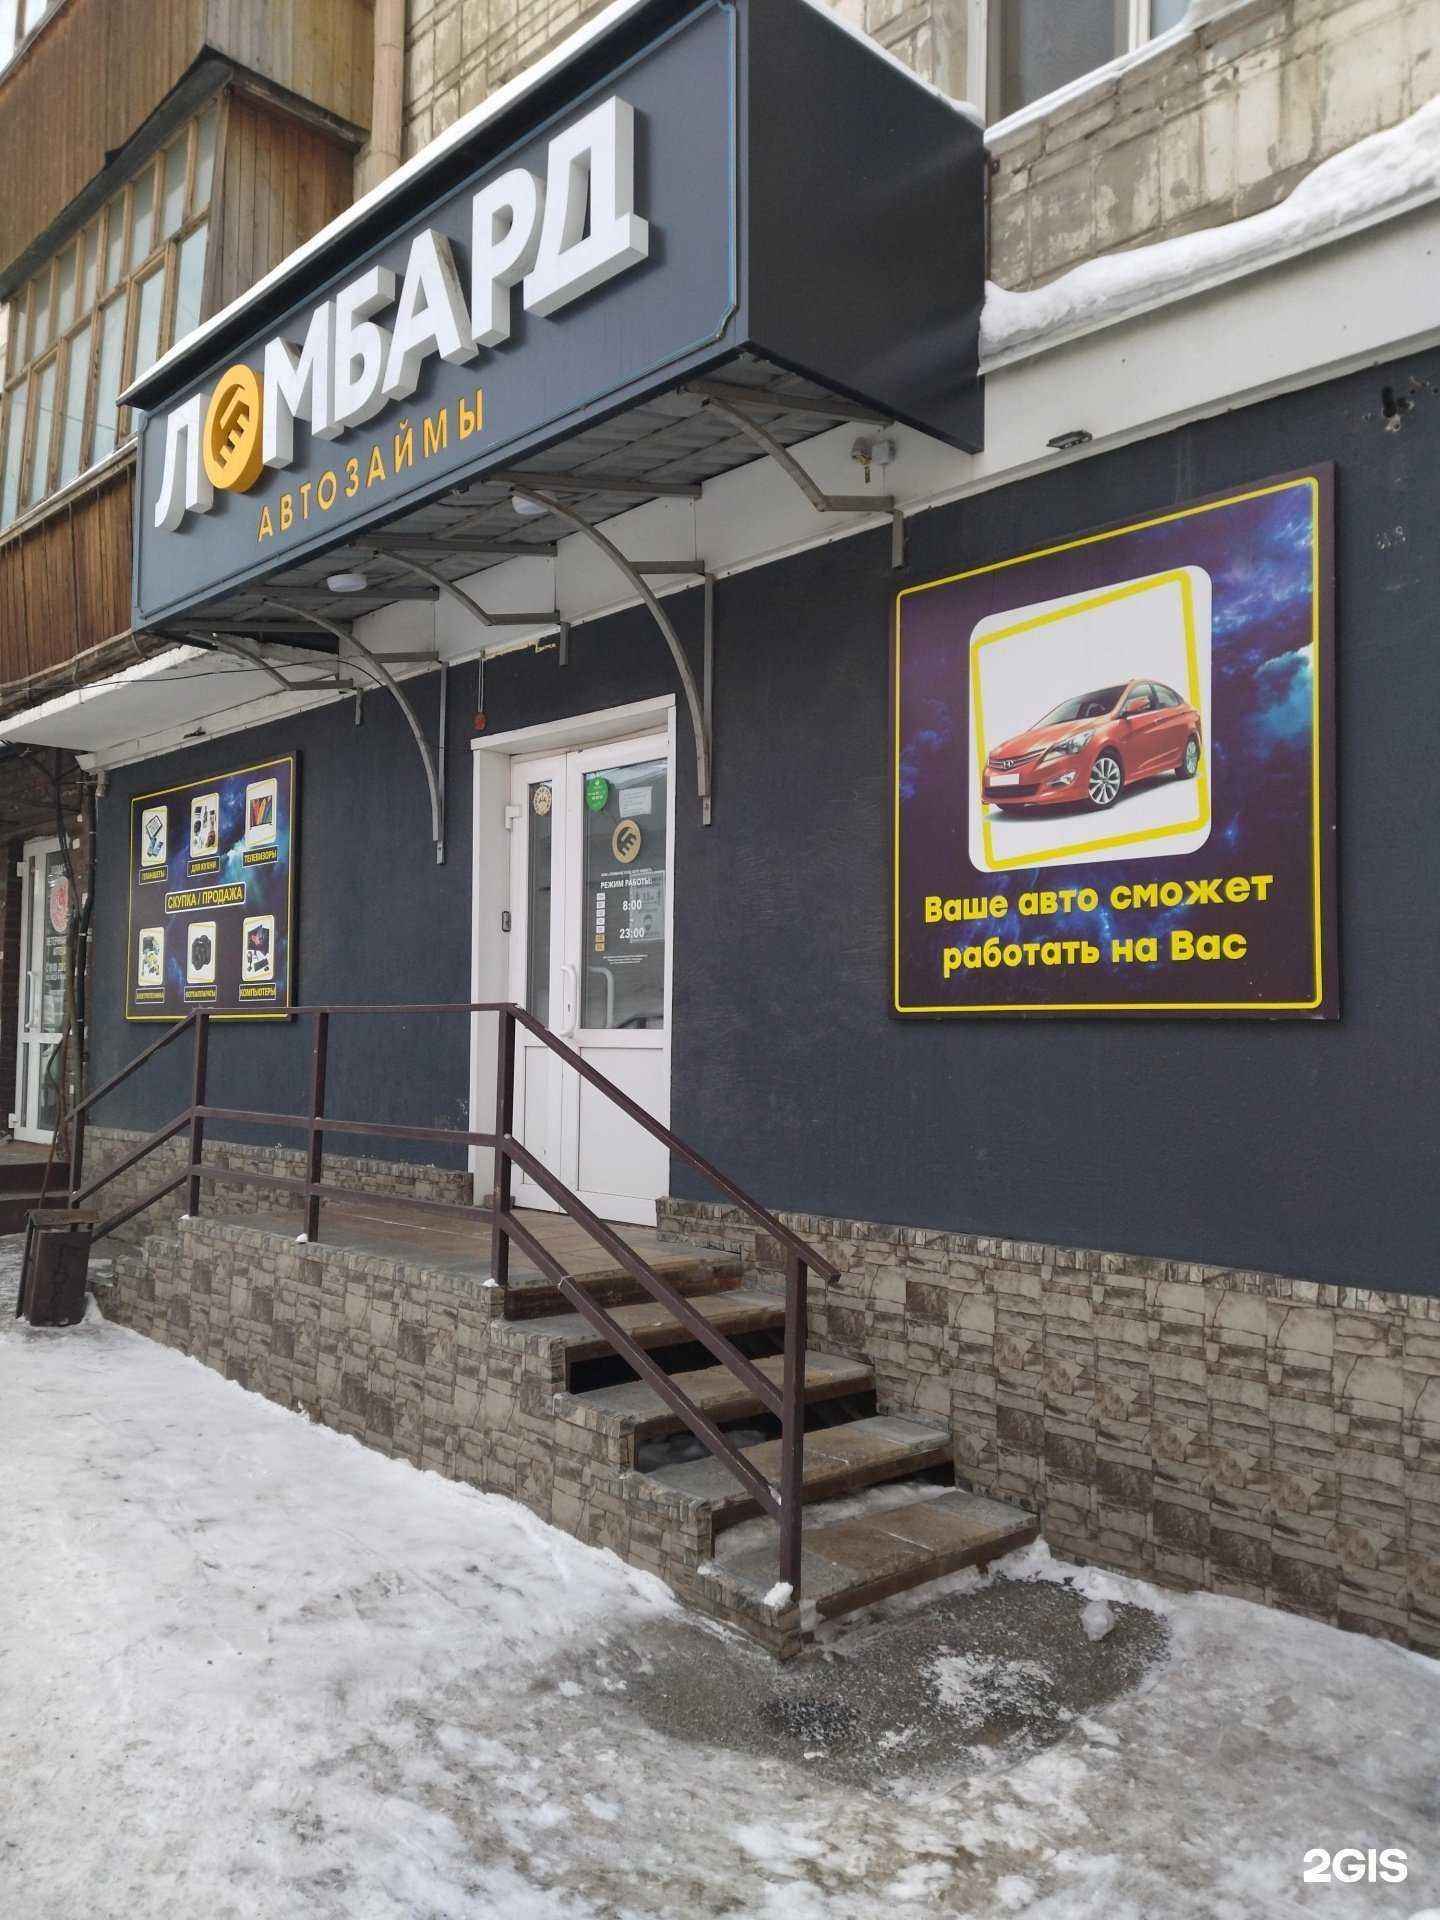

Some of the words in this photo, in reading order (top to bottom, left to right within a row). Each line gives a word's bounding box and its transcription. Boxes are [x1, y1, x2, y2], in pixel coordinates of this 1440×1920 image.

[154, 95, 650, 533] ЛОМБАРД
[256, 388, 487, 544] АВТОЗАЙМЫ
[167, 892, 197, 909] СКУПКА
[202, 886, 243, 905] ПРОДАЖА
[600, 879, 624, 889] РЕЖИМ
[924, 895, 1009, 923] Ваше
[1018, 888, 1099, 917] авто
[1109, 875, 1274, 909] сможет
[622, 899, 643, 911] 8:00
[619, 927, 646, 939] 23:00
[942, 936, 1100, 979] работать
[1111, 934, 1160, 964] на
[1170, 929, 1248, 962] Вас
